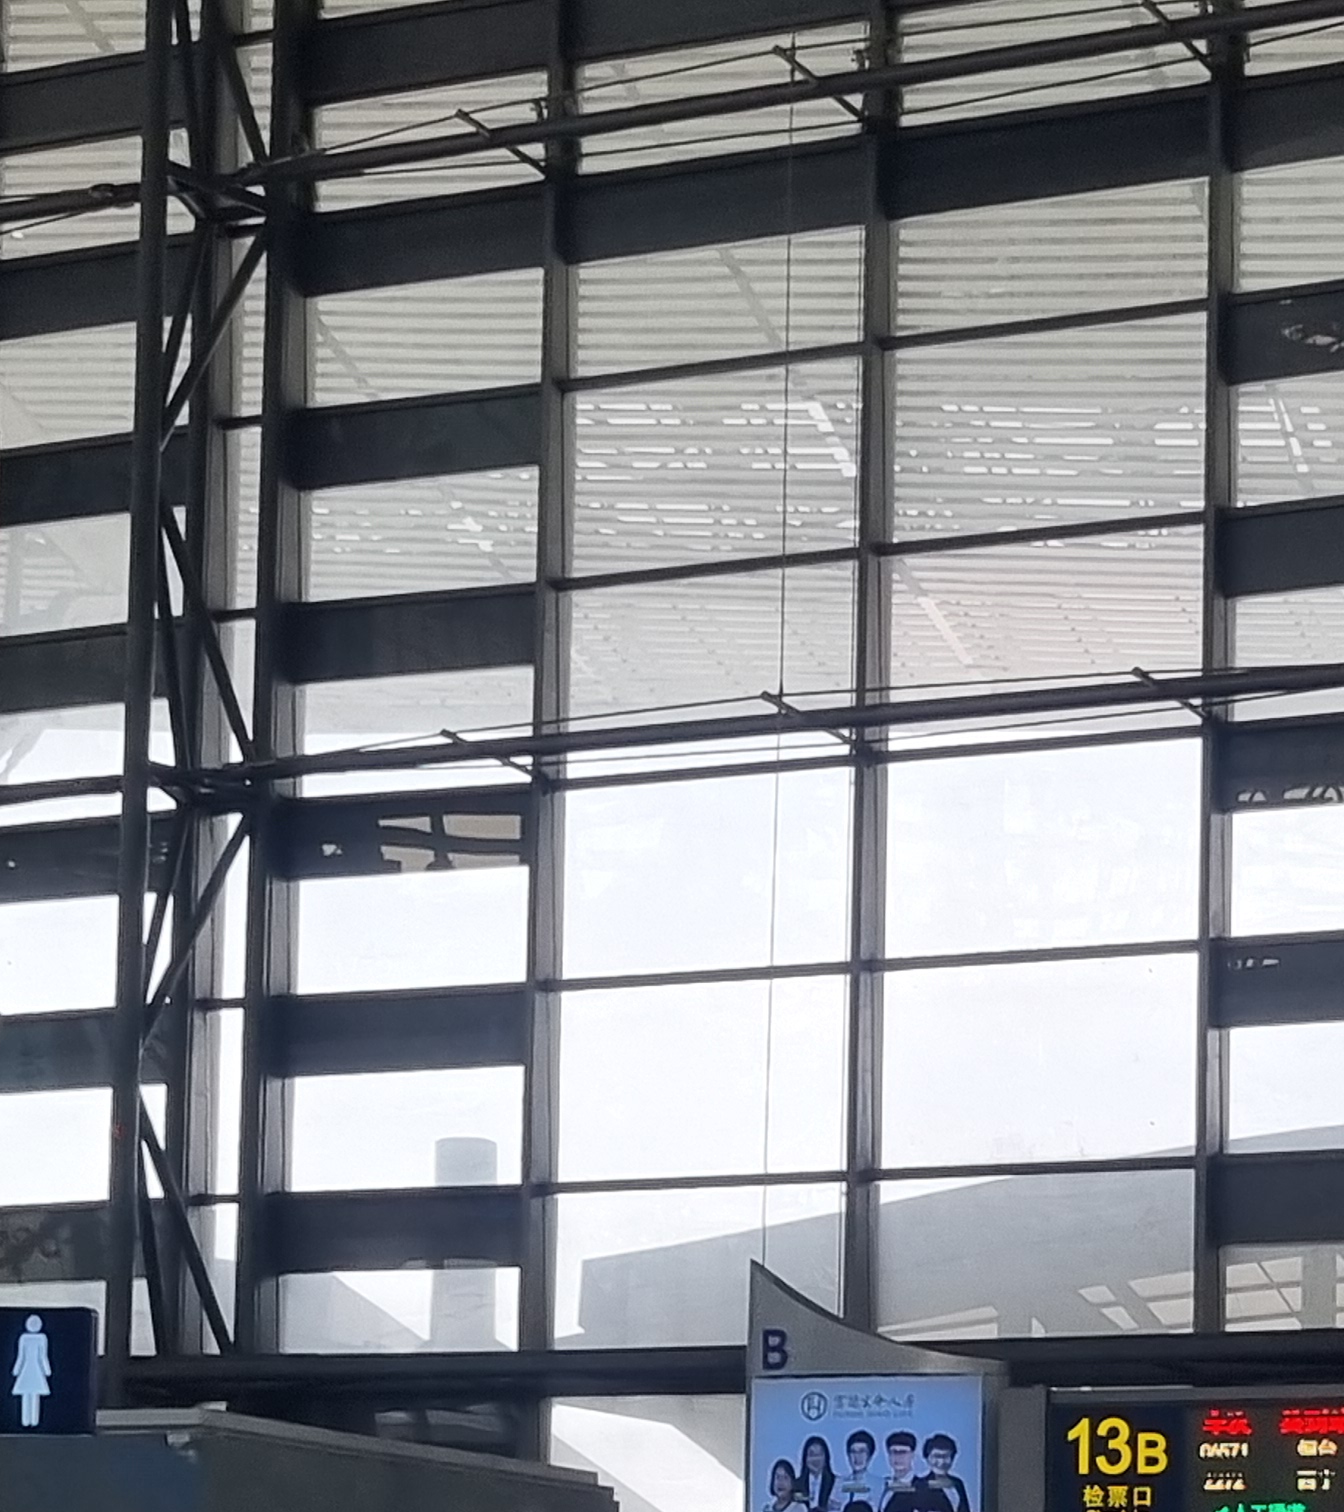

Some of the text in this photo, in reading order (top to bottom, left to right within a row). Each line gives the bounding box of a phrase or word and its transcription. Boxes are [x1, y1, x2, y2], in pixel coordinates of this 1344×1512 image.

[762, 1329, 788, 1370] B
[1067, 1417, 1169, 1475] 13B
[1083, 1485, 1152, 1507] 检票口
